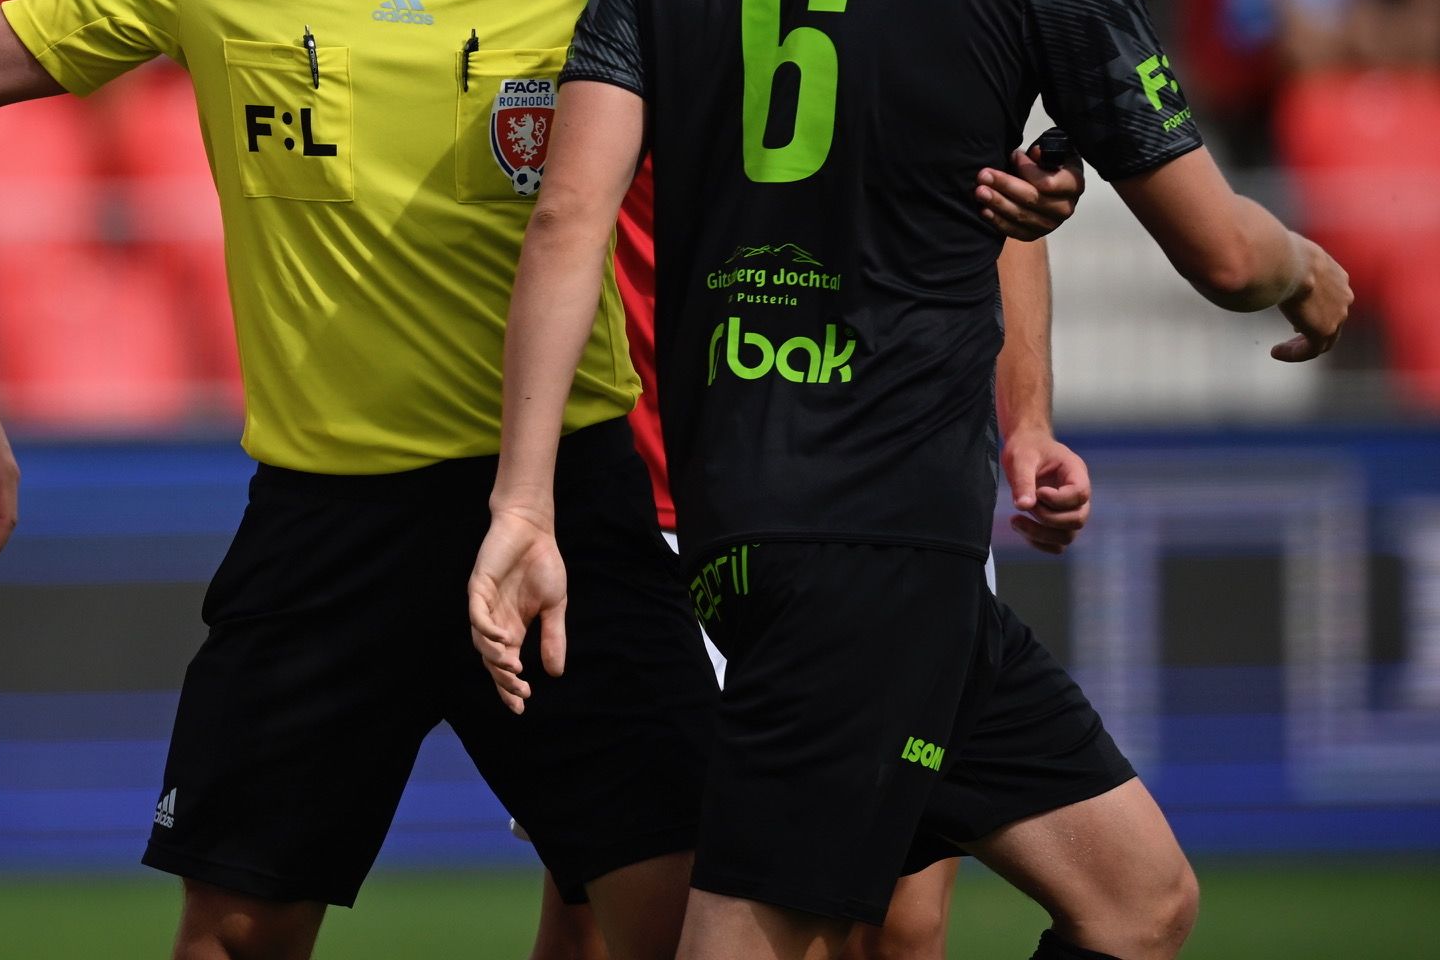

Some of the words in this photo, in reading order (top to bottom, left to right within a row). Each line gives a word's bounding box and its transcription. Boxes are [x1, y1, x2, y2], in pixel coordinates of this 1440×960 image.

[372, 9, 434, 25] adidas
[504, 79, 551, 93] FAČR
[499, 94, 554, 107] ROZHODČÍ
[245, 105, 337, 157] F:L
[737, 292, 798, 307] Pusteria
